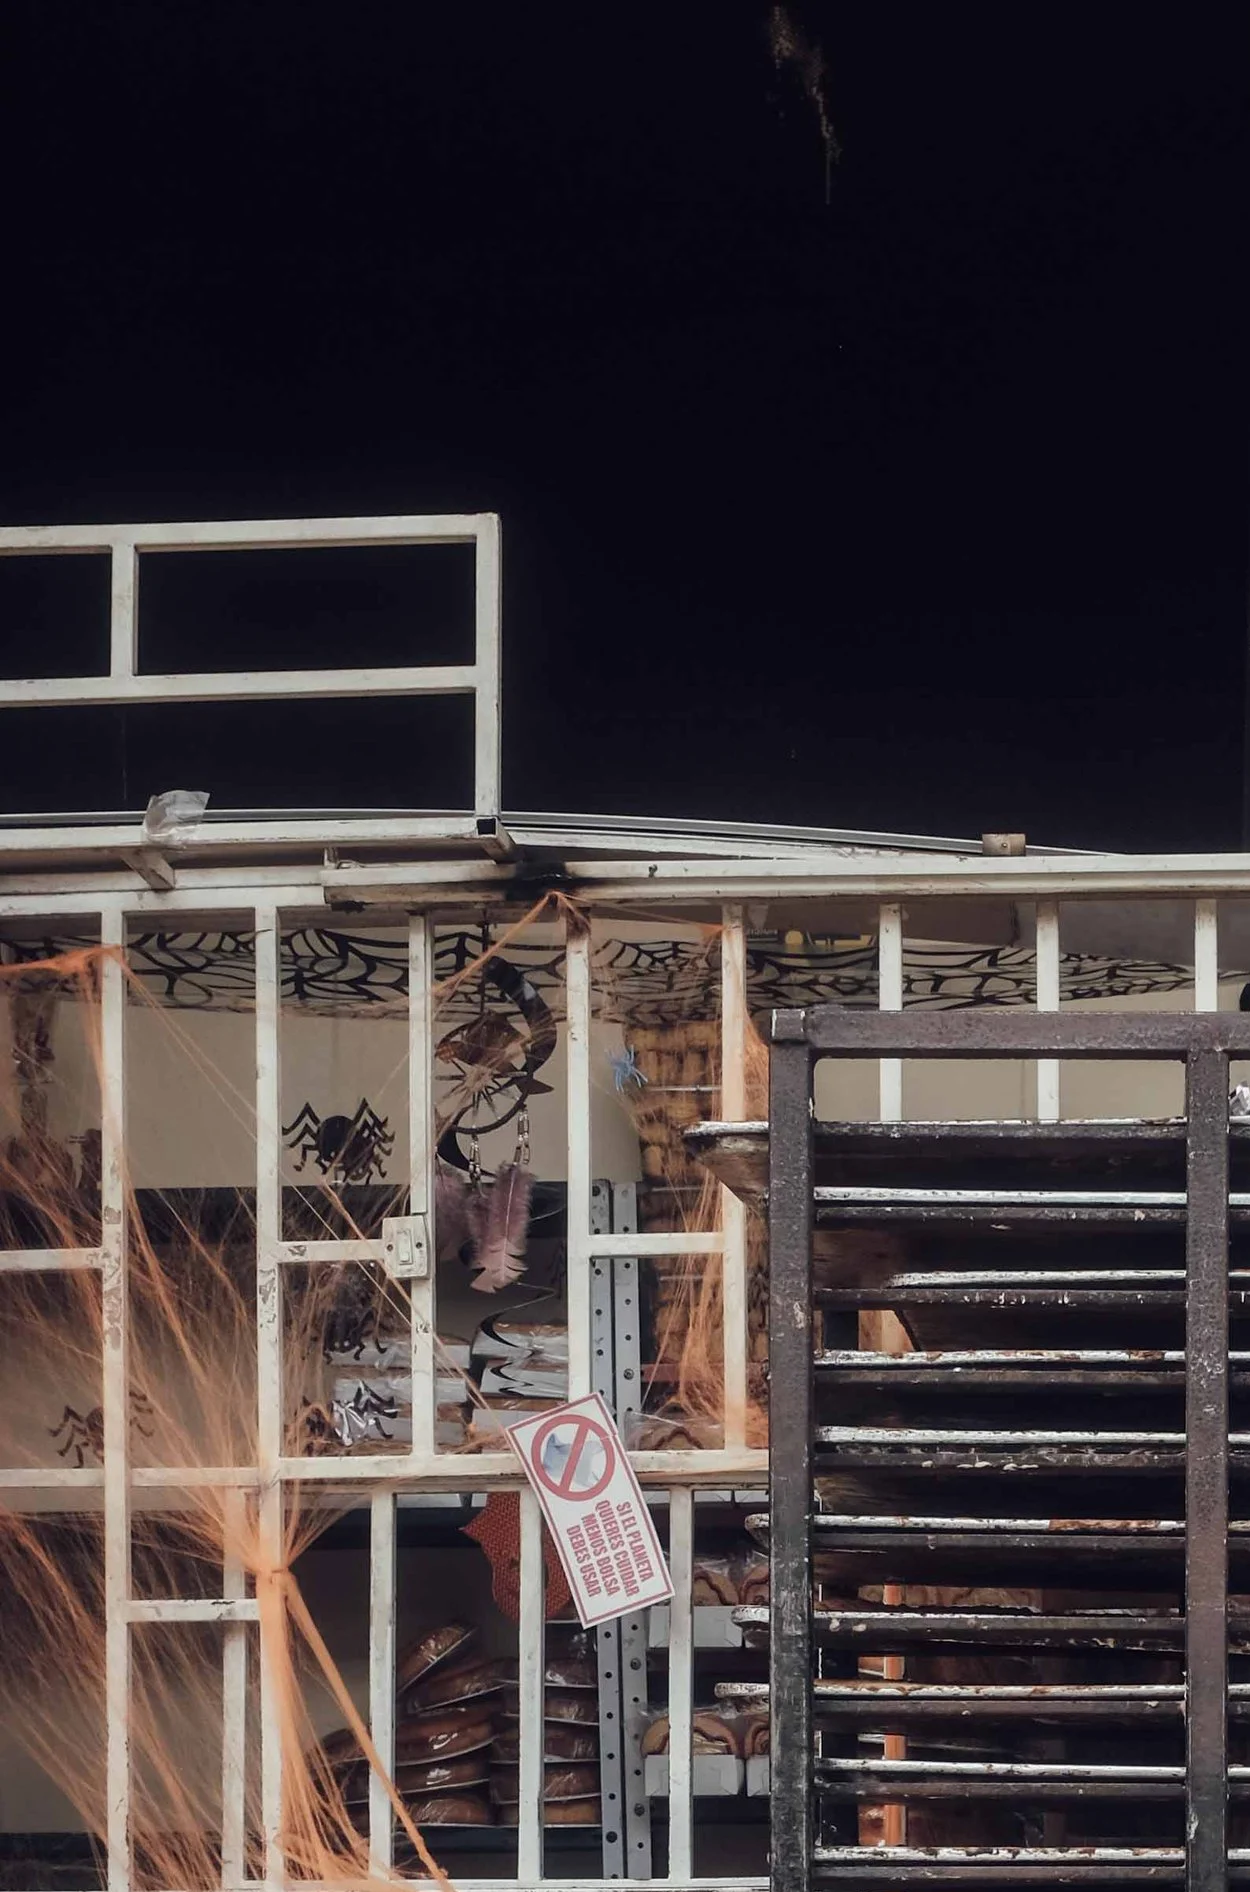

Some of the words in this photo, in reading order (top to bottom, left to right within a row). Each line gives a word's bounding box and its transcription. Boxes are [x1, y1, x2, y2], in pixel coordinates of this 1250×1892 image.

[616, 1501, 633, 1516] SI
[621, 1516, 637, 1531] EL
[566, 1525, 591, 1564] DEBES
[580, 1563, 601, 1597] USAR
[581, 1513, 608, 1556] MENOS
[596, 1556, 620, 1596] BOLSA
[595, 1500, 625, 1550] QUIERES
[614, 1550, 640, 1597] CUIDAR
[626, 1530, 654, 1582] PLANETA
